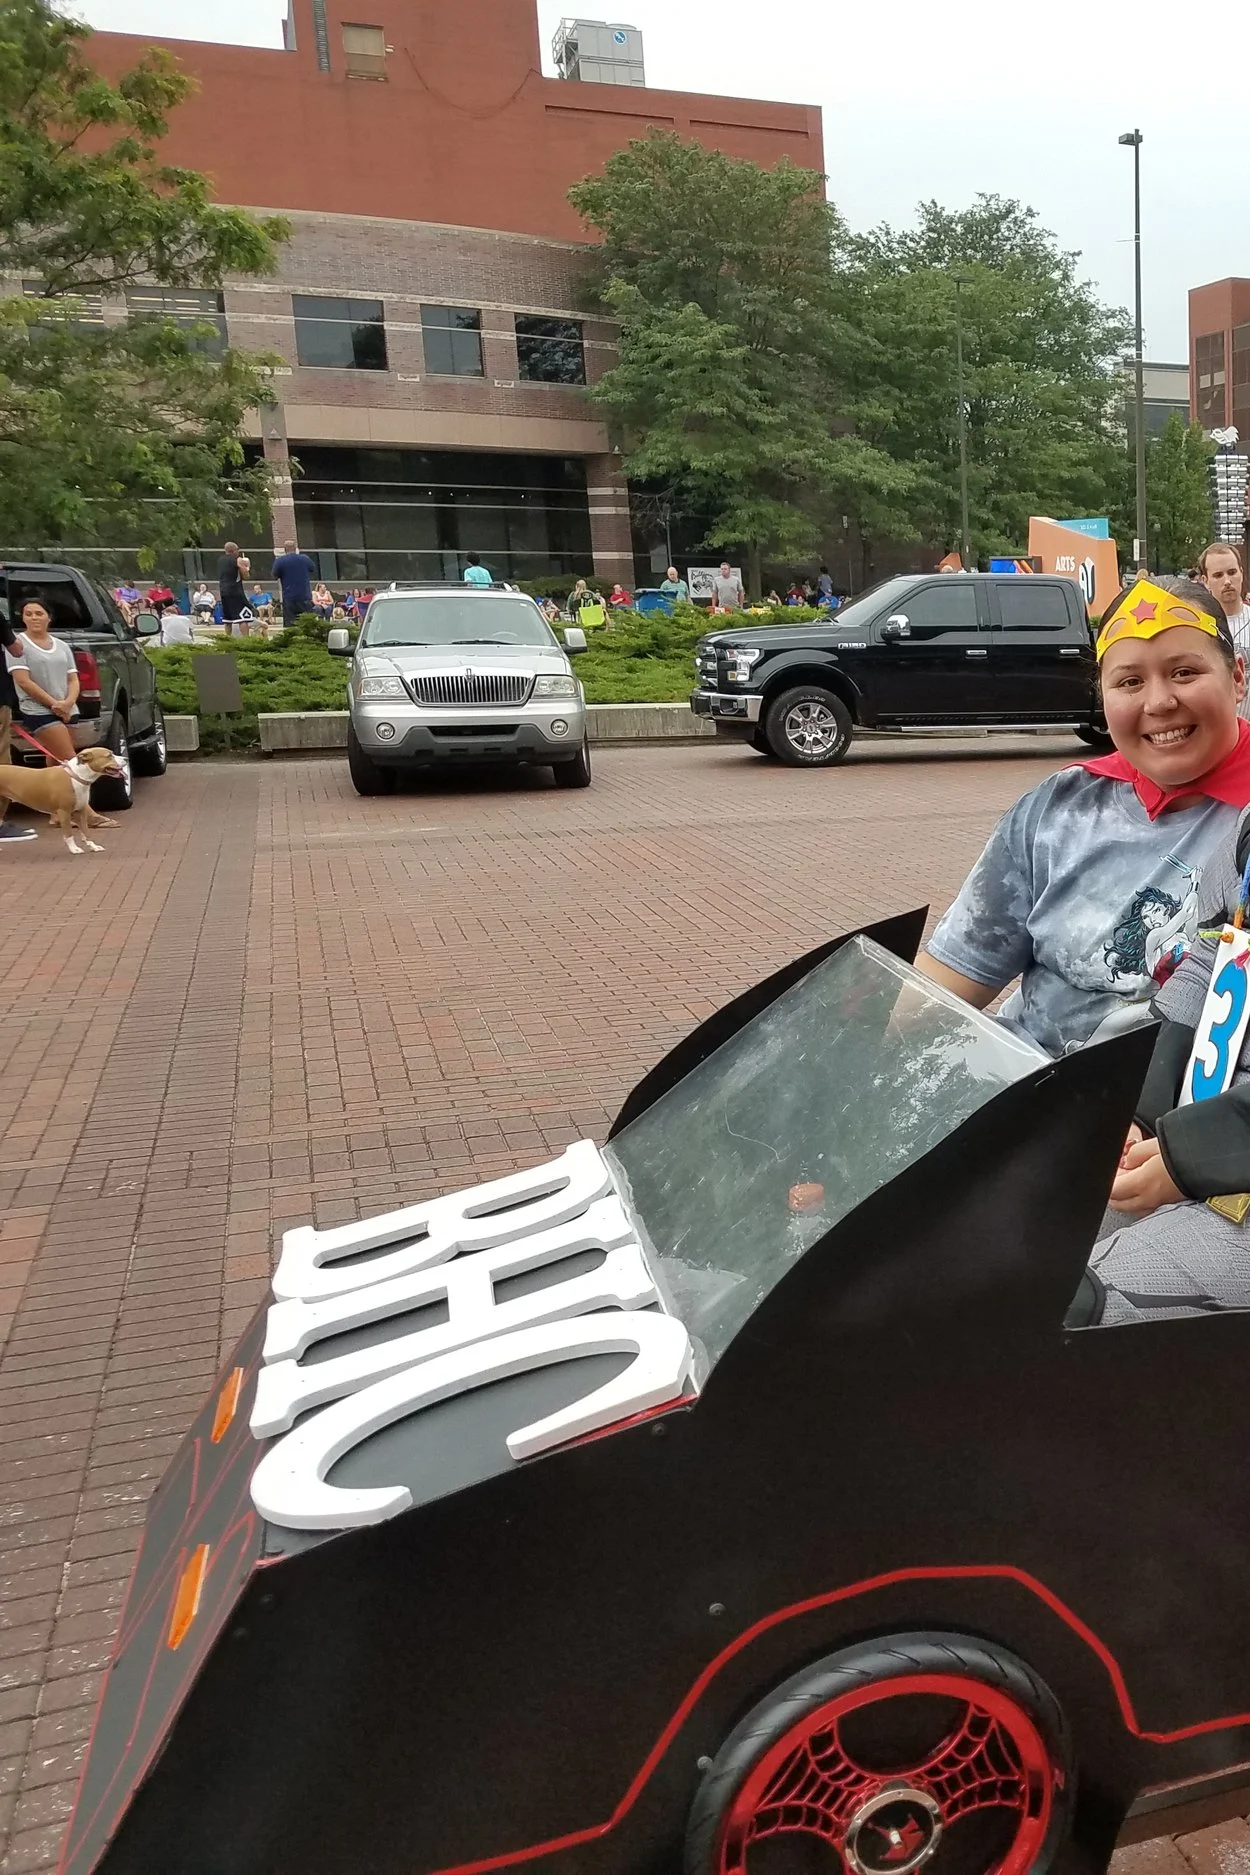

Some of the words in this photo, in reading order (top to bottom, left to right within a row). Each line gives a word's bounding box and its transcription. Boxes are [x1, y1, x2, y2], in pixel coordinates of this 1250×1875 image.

[1055, 555, 1076, 572] ARTS
[1191, 957, 1248, 1104] 3
[248, 1138, 692, 1532] BHC
